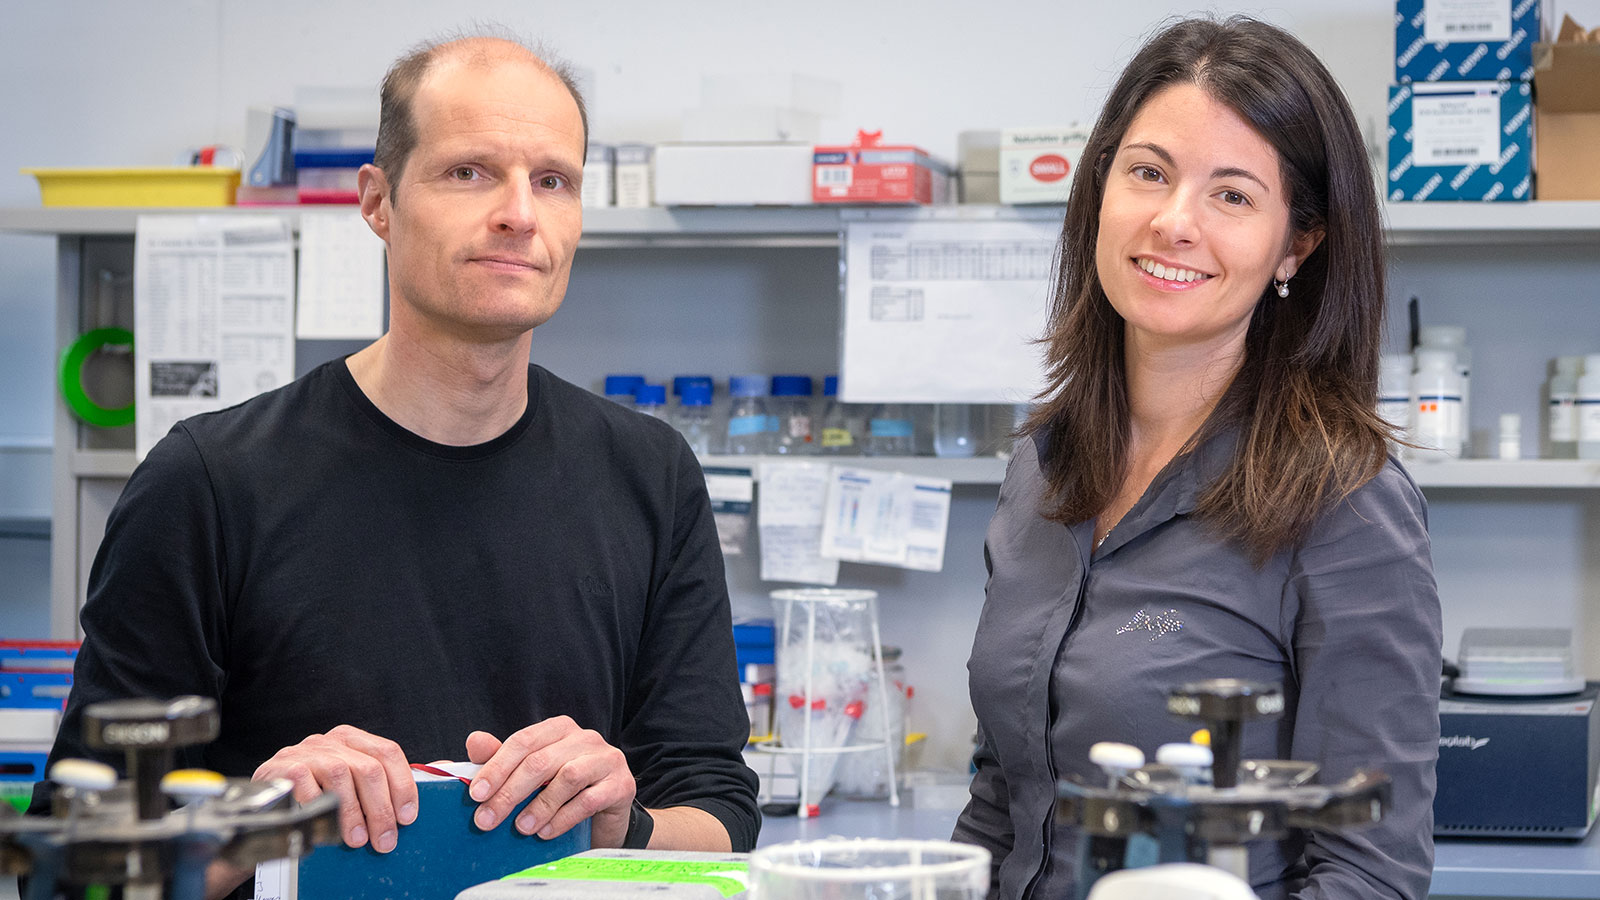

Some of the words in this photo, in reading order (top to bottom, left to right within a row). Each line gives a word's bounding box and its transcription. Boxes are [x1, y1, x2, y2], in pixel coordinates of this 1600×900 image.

[1496, 27, 1528, 60] QIAGEN
[1457, 43, 1488, 76] QIAGEN
[1033, 162, 1065, 174] SMALL
[1439, 734, 1476, 748] eqlab
